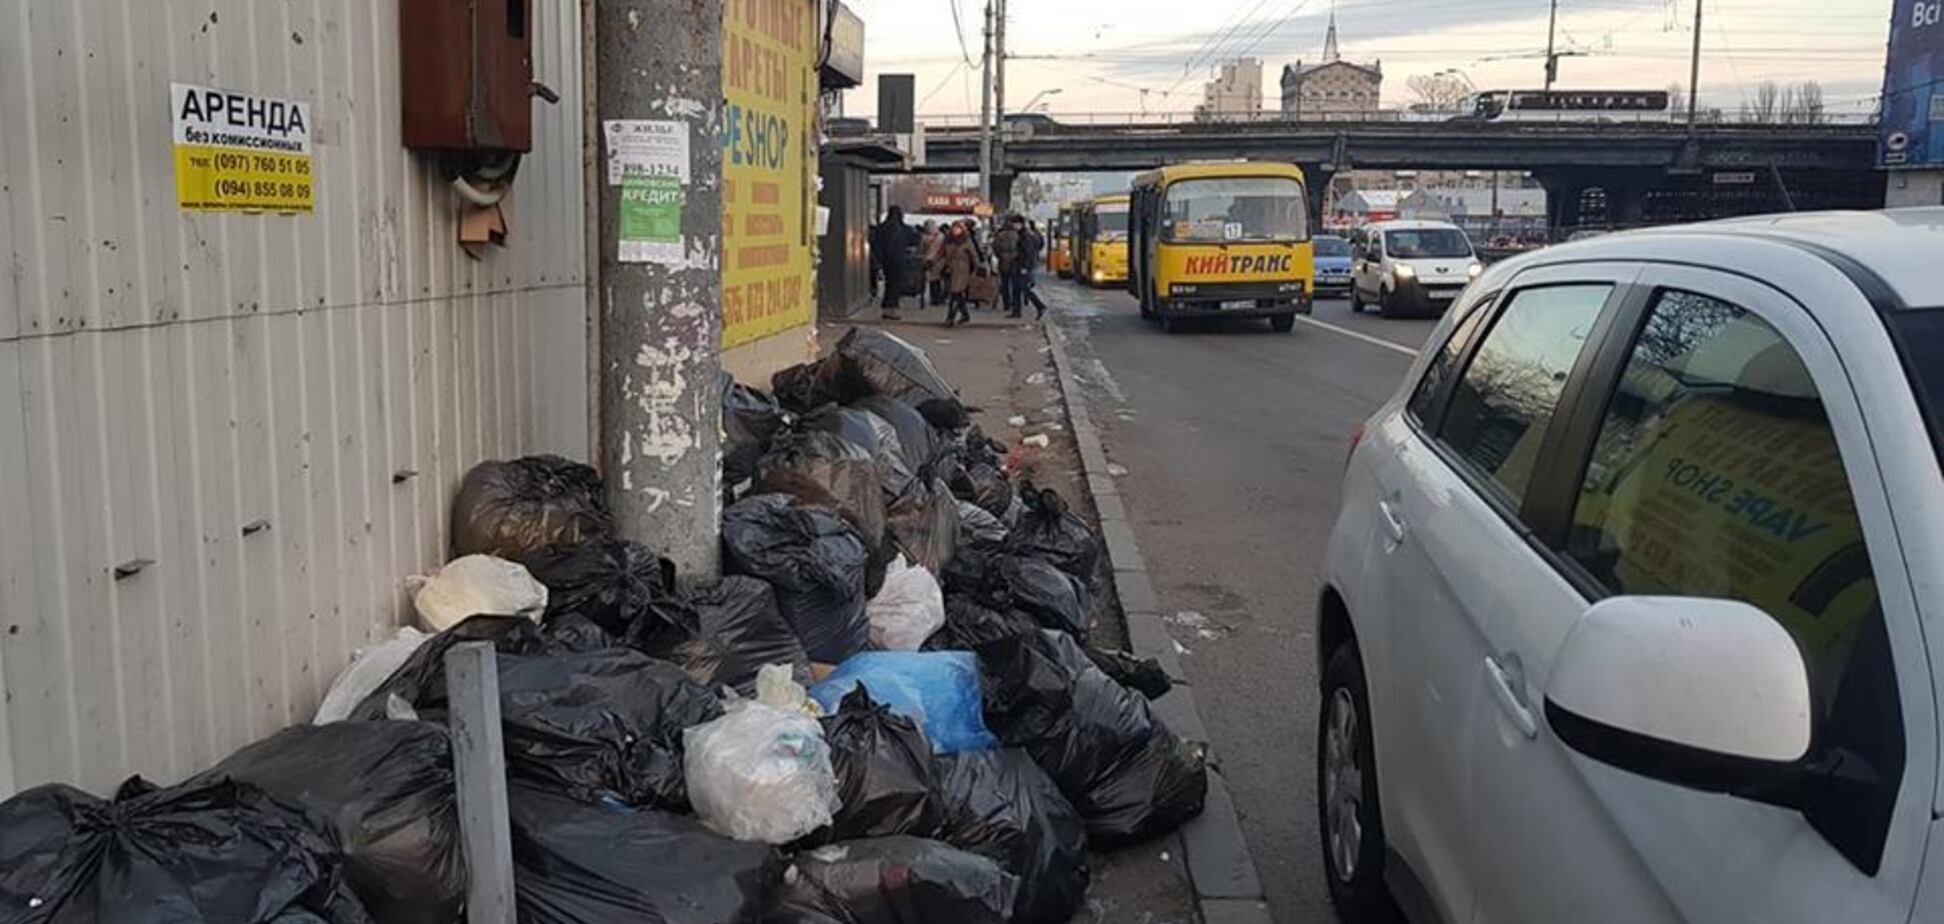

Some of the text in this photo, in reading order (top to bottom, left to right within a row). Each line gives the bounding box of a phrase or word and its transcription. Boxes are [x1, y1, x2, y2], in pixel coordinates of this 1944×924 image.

[180, 88, 306, 138] АРЕНДА
[185, 126, 303, 152] без комиссионных
[746, 109, 788, 170] SHOP
[213, 153, 251, 173] (097)
[253, 156, 277, 173] 760
[279, 158, 293, 174] 51
[294, 160, 311, 175] 05
[214, 179, 311, 200] (094) 855 08 09
[622, 188, 678, 205] КРЕДИТ
